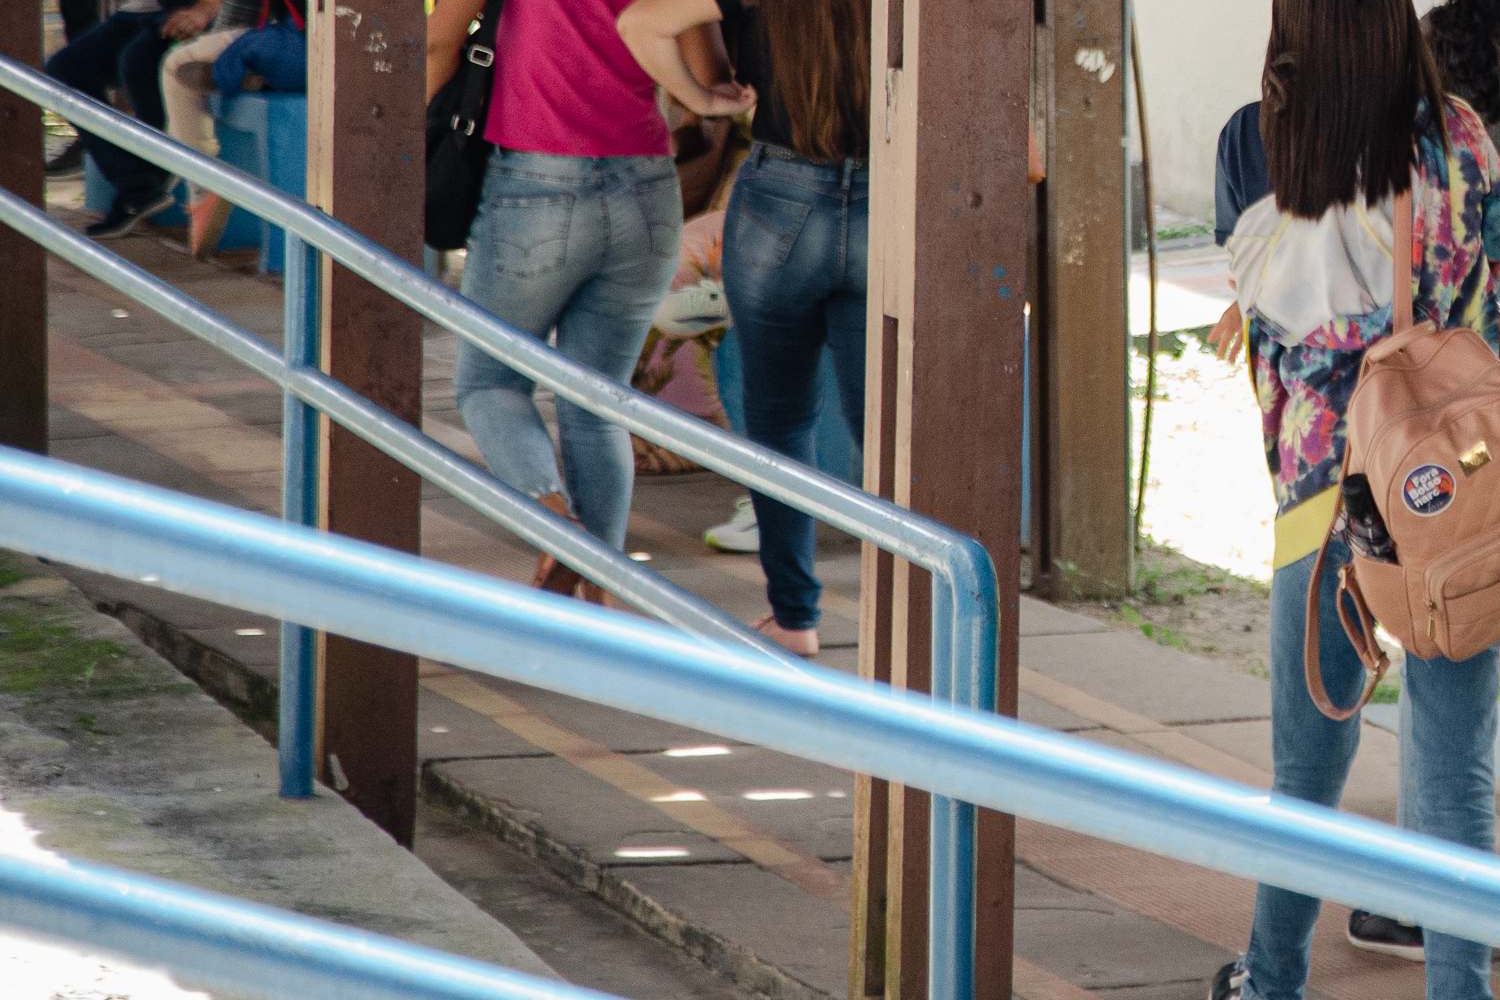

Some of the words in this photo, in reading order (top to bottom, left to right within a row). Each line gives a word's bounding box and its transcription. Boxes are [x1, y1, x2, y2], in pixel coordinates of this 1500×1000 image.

[1411, 468, 1439, 487] Fora
[1408, 476, 1442, 500] Bolso
[1413, 489, 1440, 508] naro
